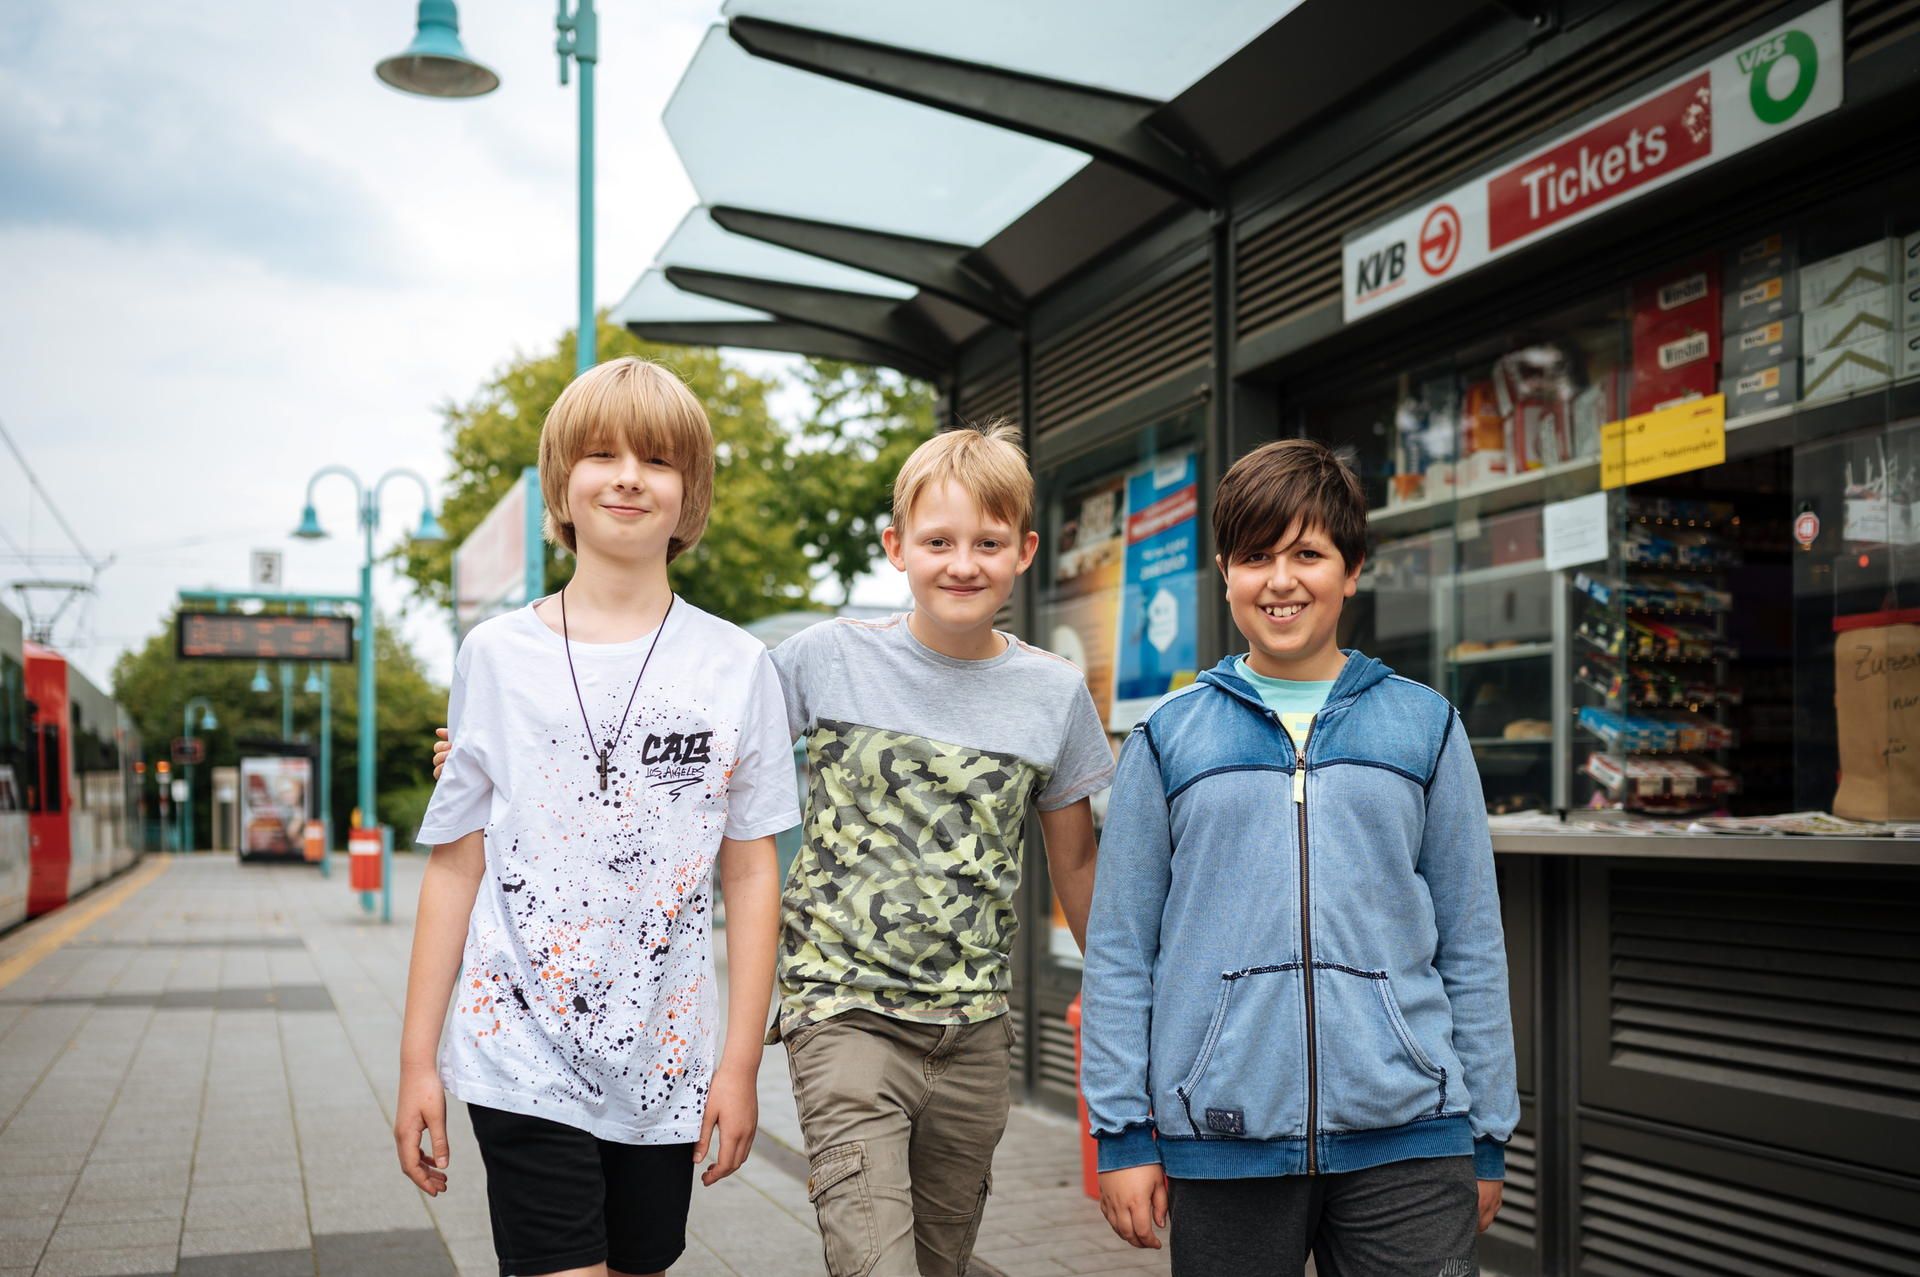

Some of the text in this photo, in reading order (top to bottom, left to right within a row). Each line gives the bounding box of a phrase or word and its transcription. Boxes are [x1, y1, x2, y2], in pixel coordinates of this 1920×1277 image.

[1739, 32, 1788, 73] VRS
[1520, 125, 1668, 219] Tickets
[1356, 240, 1407, 297] KVB
[1663, 337, 1705, 364] Winston
[641, 730, 713, 766] CALI
[645, 766, 705, 779] LOS ANGELES
[1444, 1258, 1471, 1275] NIKE
